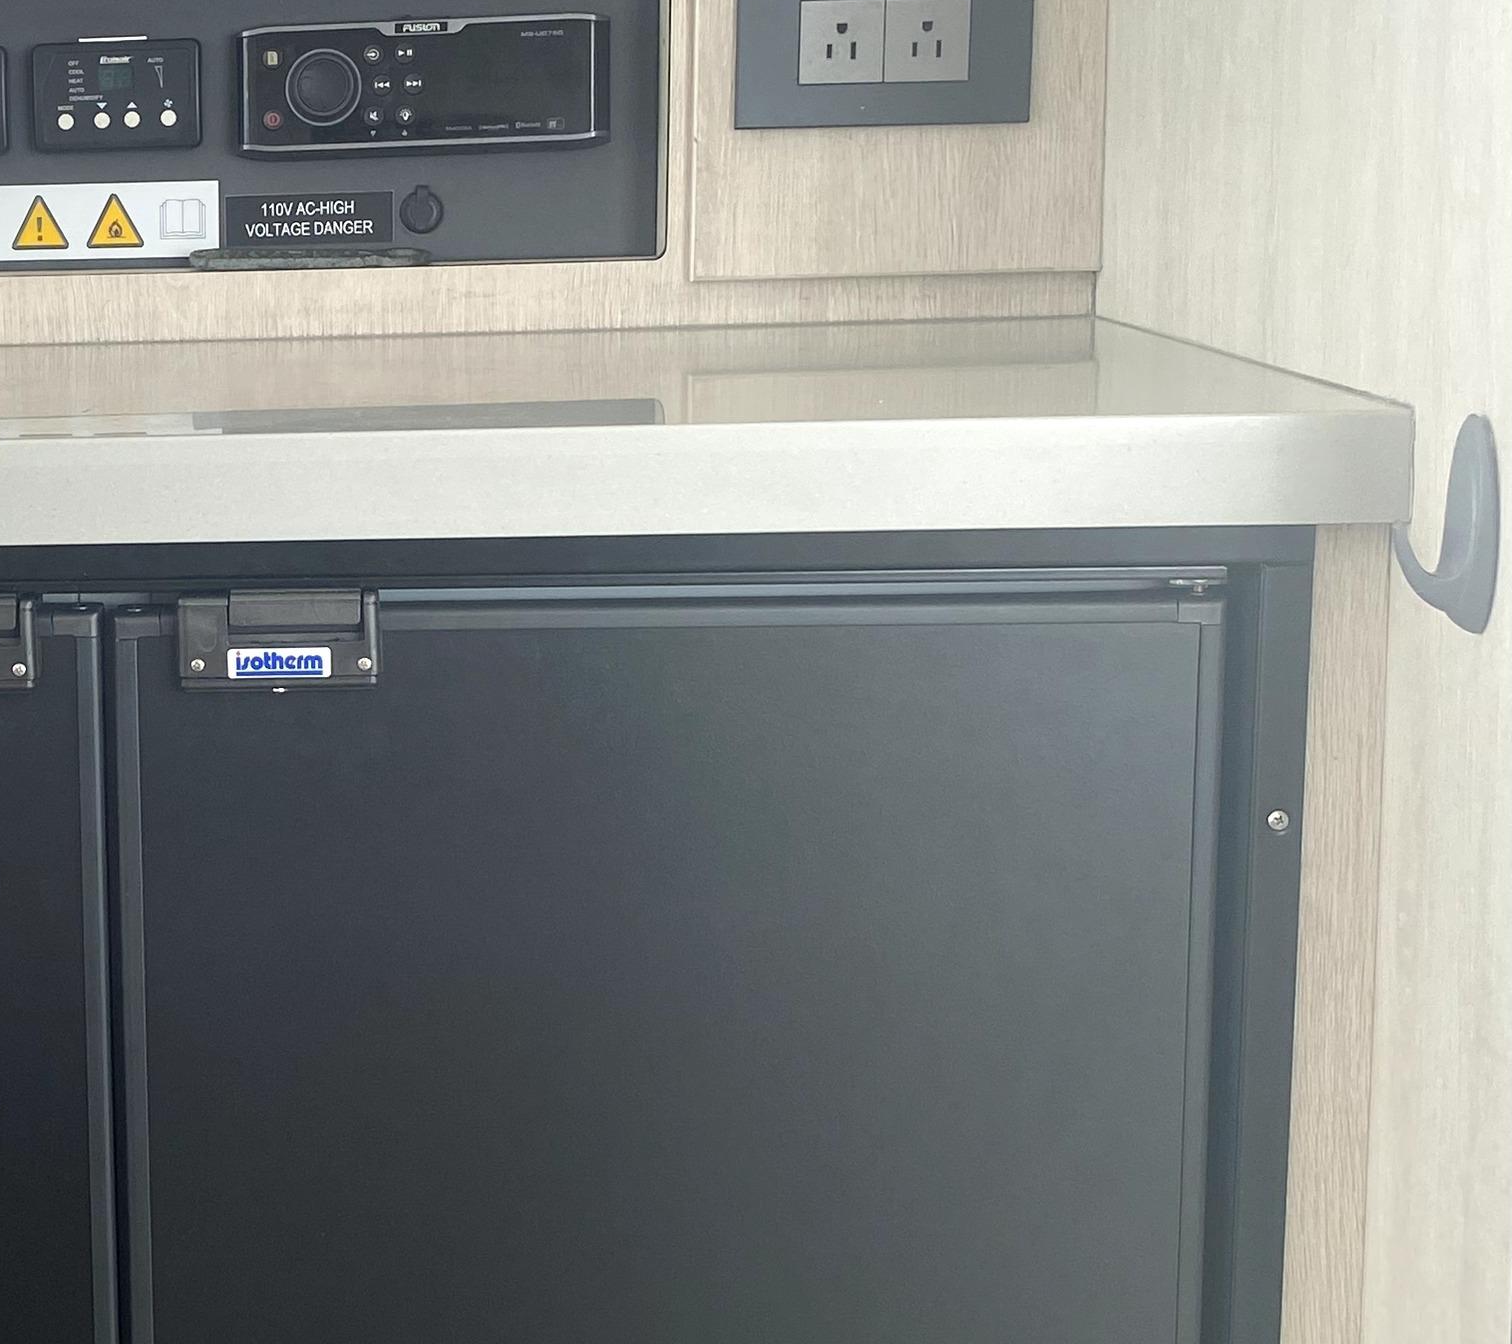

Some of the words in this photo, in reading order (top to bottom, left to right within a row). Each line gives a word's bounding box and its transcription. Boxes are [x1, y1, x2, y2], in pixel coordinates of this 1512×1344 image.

[402, 22, 441, 32] FUSION
[261, 202, 293, 216] 110V
[296, 200, 355, 216] AC-HIGH
[245, 221, 311, 237] VOLTAGE
[314, 220, 374, 235] DANGER
[236, 651, 323, 670] isotherm
